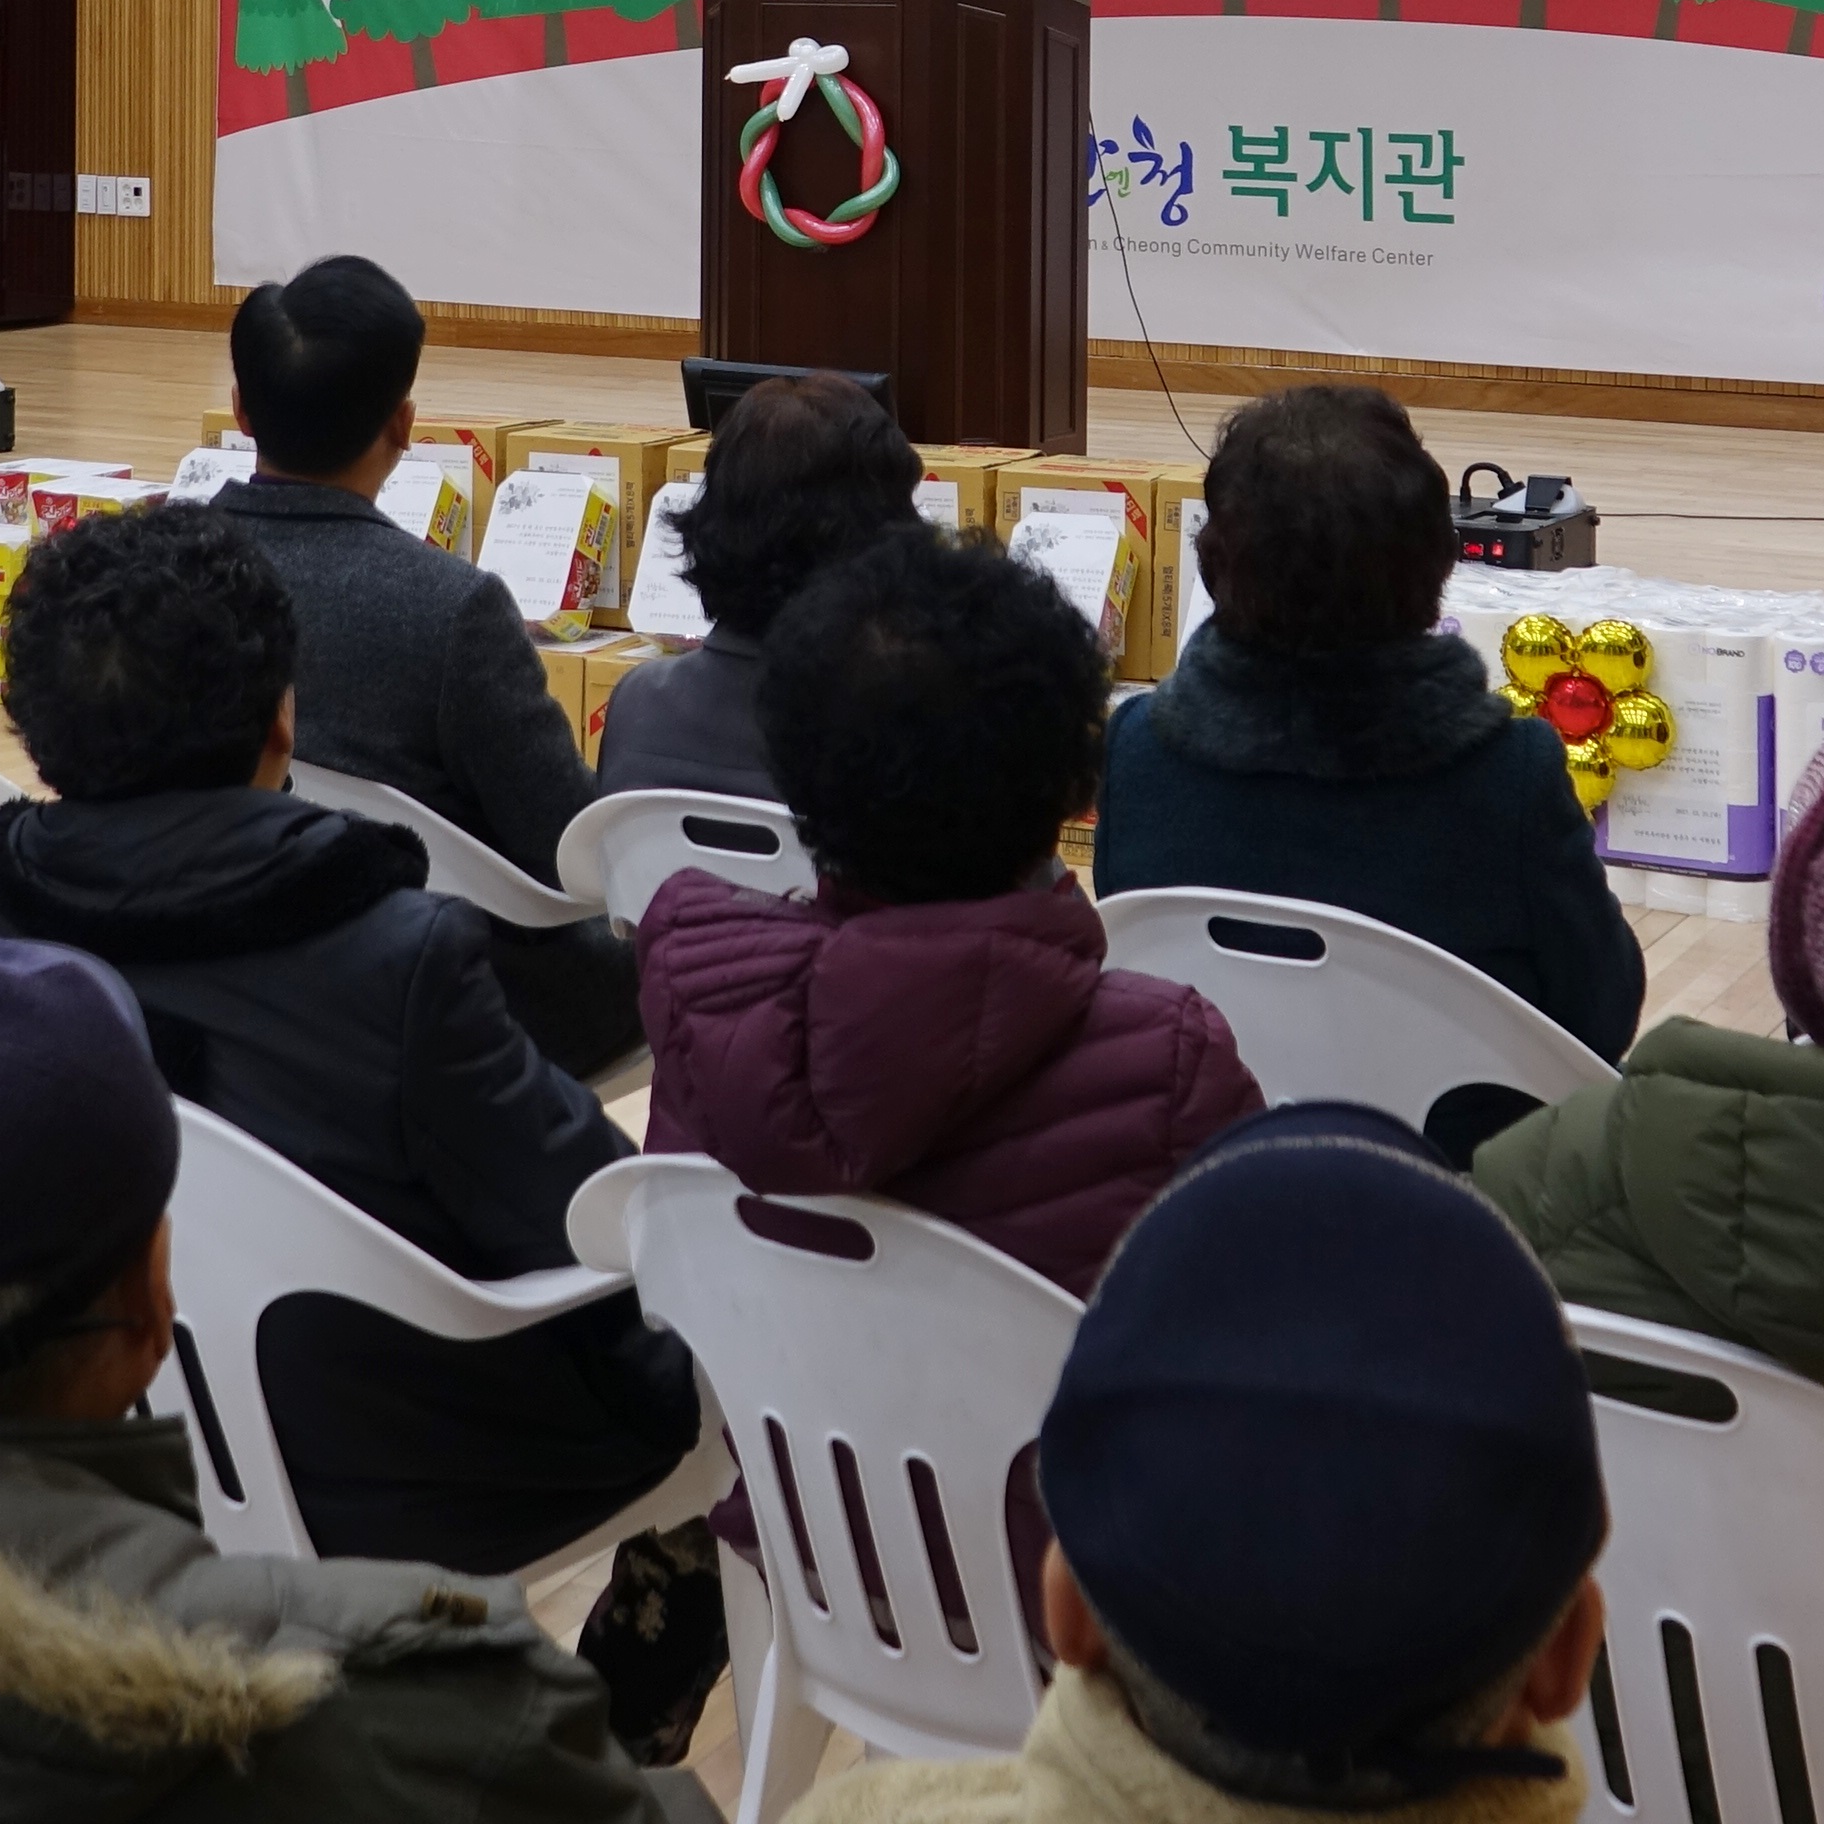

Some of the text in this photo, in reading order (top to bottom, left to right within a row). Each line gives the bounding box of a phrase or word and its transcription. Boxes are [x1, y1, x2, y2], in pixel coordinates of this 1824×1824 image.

[1223, 125, 1465, 226] 복지관
[1113, 236, 1182, 258] Cheong
[1187, 239, 1290, 262] Community
[1295, 243, 1367, 264] Welfare
[1372, 248, 1434, 267] Center
